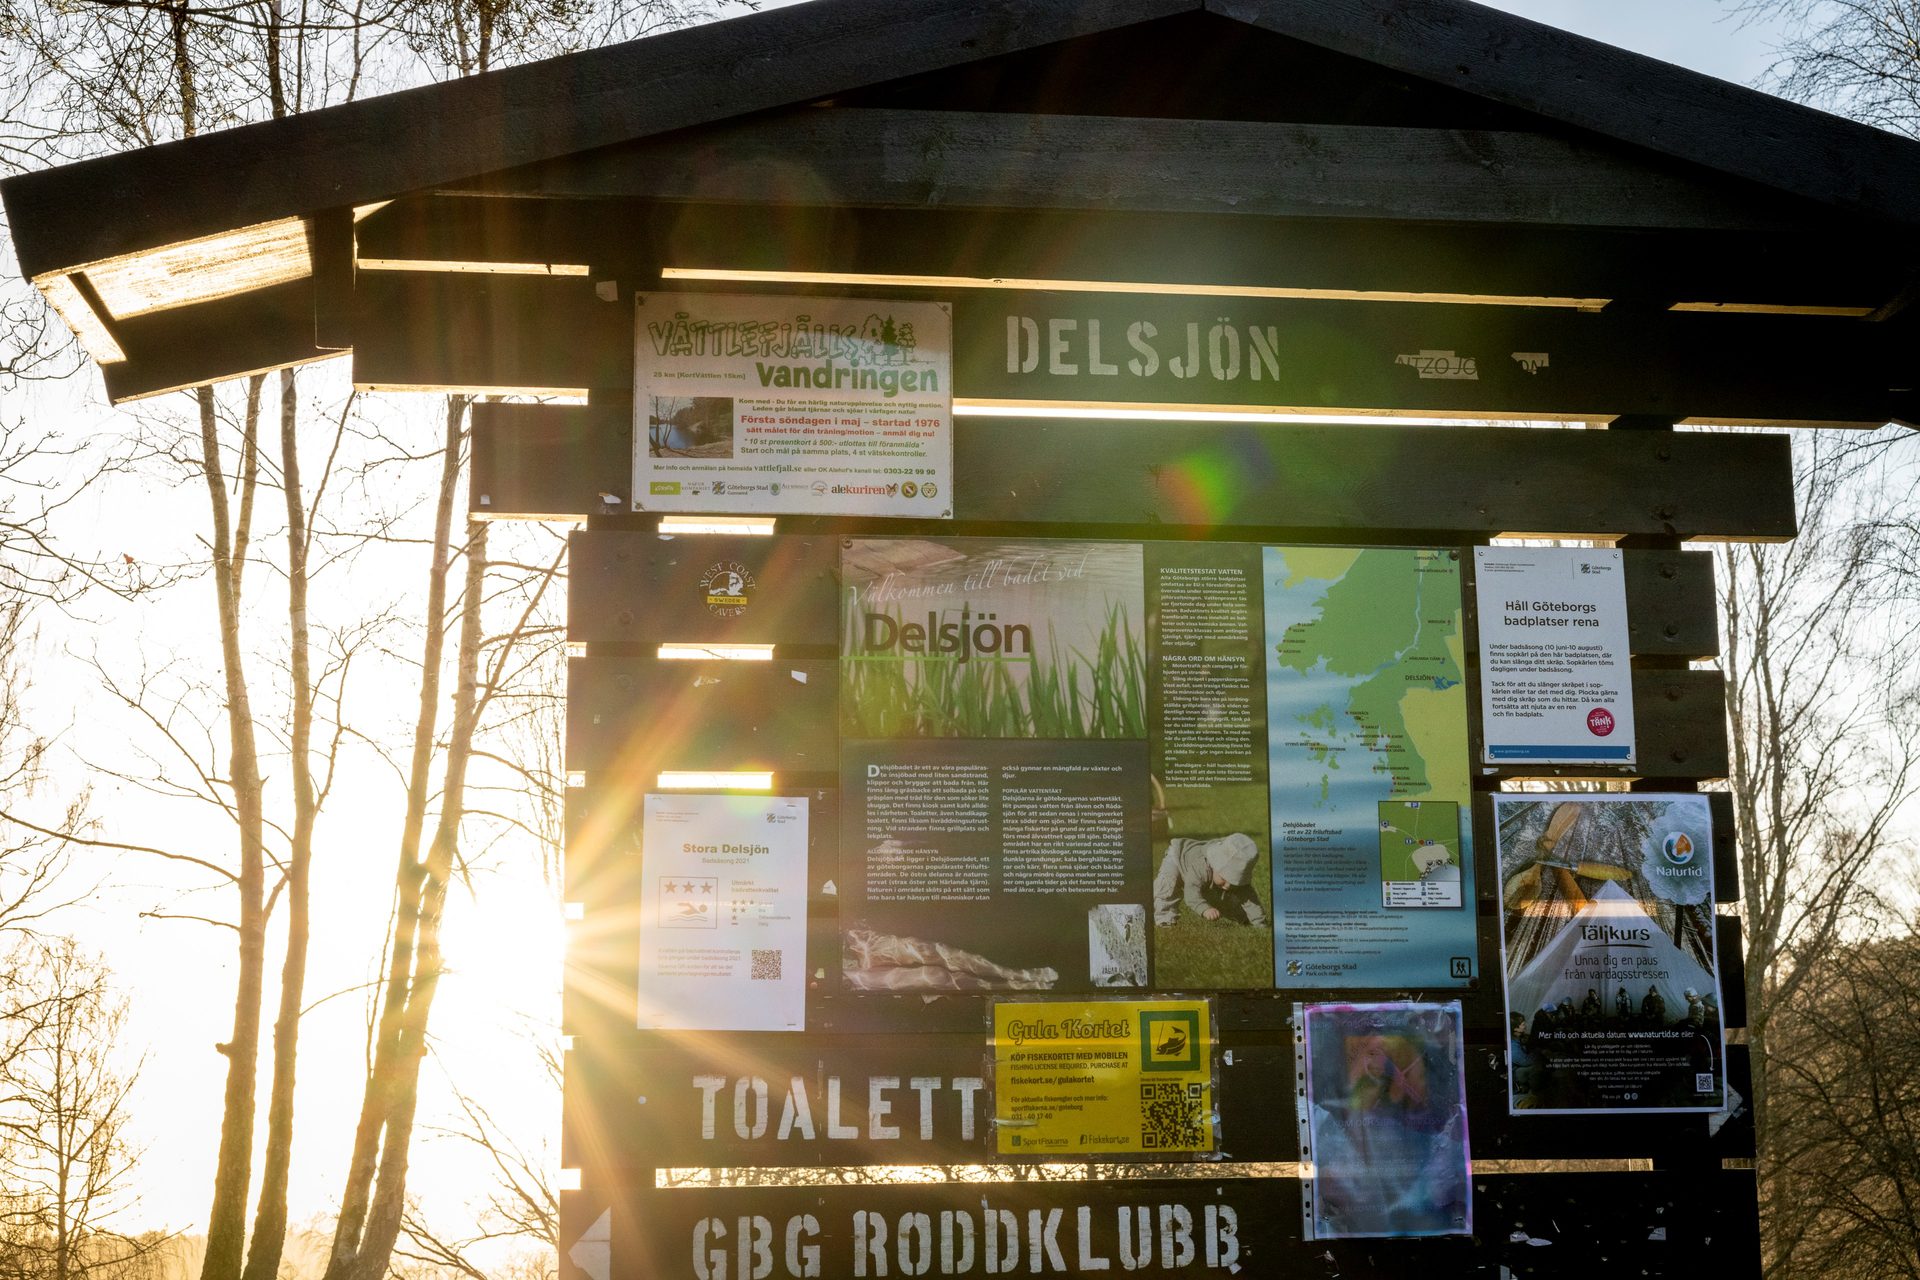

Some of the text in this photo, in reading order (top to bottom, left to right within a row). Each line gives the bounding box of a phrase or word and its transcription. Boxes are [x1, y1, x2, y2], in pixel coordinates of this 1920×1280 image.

[1006, 316, 1280, 382] DELSJÖN
[755, 359, 939, 398] vandringen
[741, 415, 776, 424] Första
[779, 416, 831, 427] söndagen
[841, 417, 860, 427] maj
[872, 418, 911, 427] startad
[915, 419, 940, 427] 1976
[792, 448, 800, 456] på
[831, 484, 885, 495] alekuriren
[700, 562, 756, 589] WEST COAST
[850, 548, 1096, 606] Välkommen till badet vid
[709, 604, 747, 617] CAVERS
[1506, 601, 1596, 614] Håll Göteborgs
[1505, 616, 1599, 628] badplatser rena
[864, 611, 1031, 664] Delsjön
[684, 844, 769, 856] Stora Delsjön
[1656, 866, 1703, 877] Naturtid
[1579, 925, 1651, 944] Täljkurs
[1575, 955, 1658, 968] Unna dig en paus
[1565, 969, 1669, 983] från vardagsstressen
[1008, 1018, 1131, 1045] Gula Kortet
[1554, 1031, 1566, 1039] info
[1628, 1030, 1679, 1038] www.naturtid.se
[1011, 1053, 1026, 1061] KÖP
[1027, 1053, 1074, 1061] FISKEKORTET
[1094, 1052, 1128, 1060] MOBILEN
[1011, 1075, 1095, 1085] fiskekort.se/gulakortet
[692, 1075, 986, 1142] TOALETT
[693, 1204, 1240, 1280] GBG RODDKLUBB
